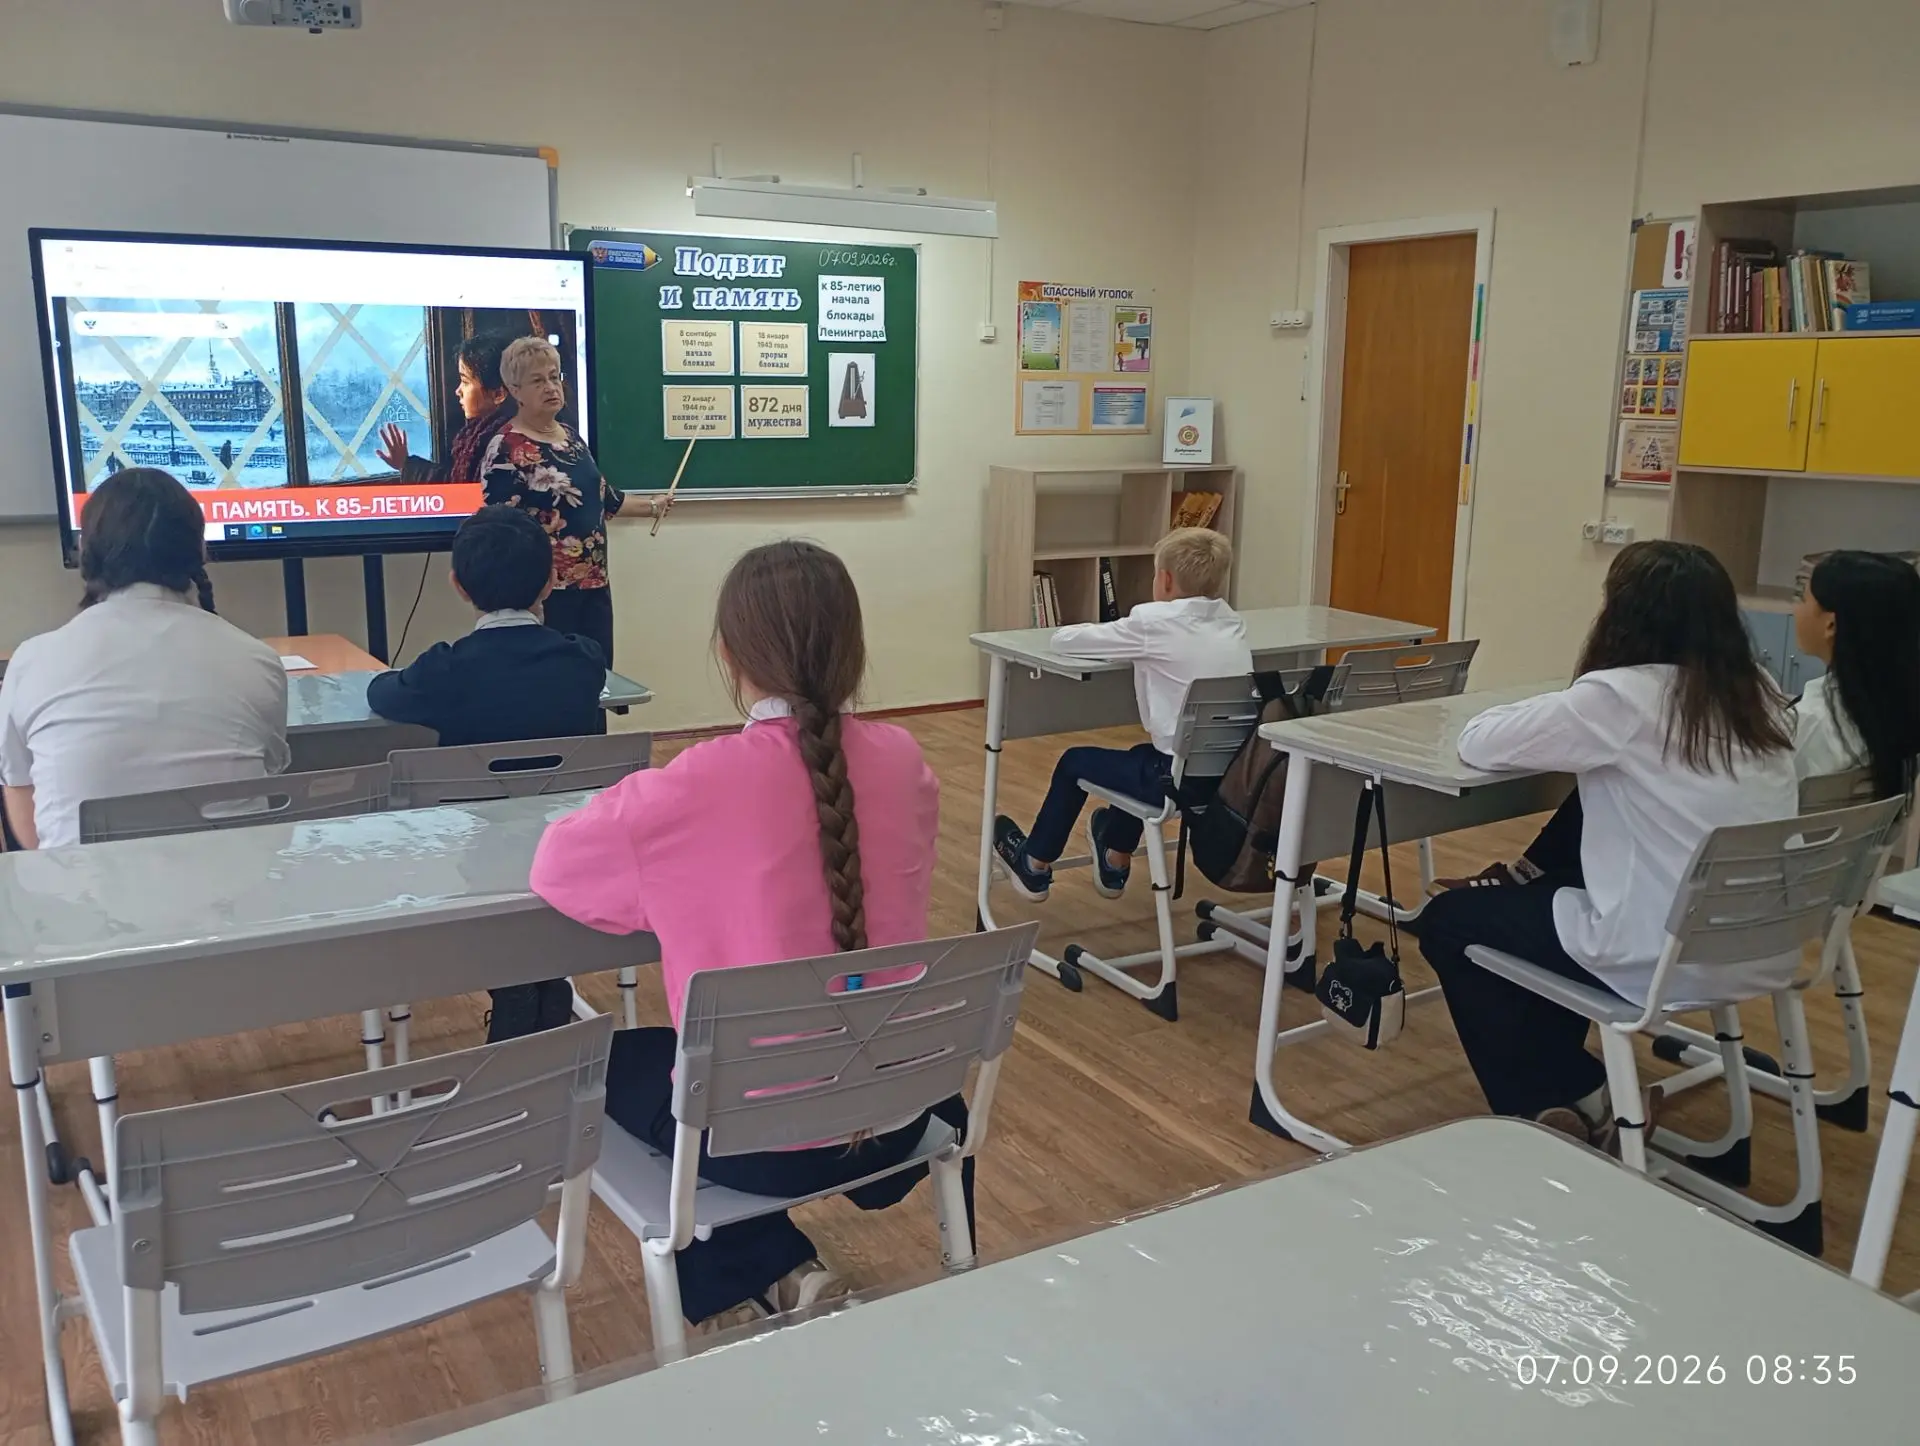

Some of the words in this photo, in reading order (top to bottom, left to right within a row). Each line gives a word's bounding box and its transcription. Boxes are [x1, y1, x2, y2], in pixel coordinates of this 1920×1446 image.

[676, 247, 784, 277] Подвиг
[821, 282, 828, 290] к
[830, 280, 882, 292] 85-летию
[661, 287, 681, 307] и
[694, 288, 801, 308] память
[1043, 286, 1096, 299] КЛАССНЫЙ
[1098, 288, 1134, 300] УГОЛОК
[831, 295, 870, 305] начала
[826, 309, 875, 322] блокады
[685, 330, 717, 339] сентября
[820, 327, 885, 339] Ленинграда
[760, 352, 788, 360] прорыв
[682, 359, 716, 367] блокады
[758, 360, 790, 368] блокады
[682, 403, 698, 411] 1944
[748, 396, 779, 413] 872
[781, 404, 802, 414] дня
[683, 423, 716, 431] блоады
[747, 418, 802, 430] мужества
[212, 500, 311, 520] ПАМЯТЬ.
[316, 498, 331, 516] К
[336, 495, 445, 515] 85-ЛЕТИЮ
